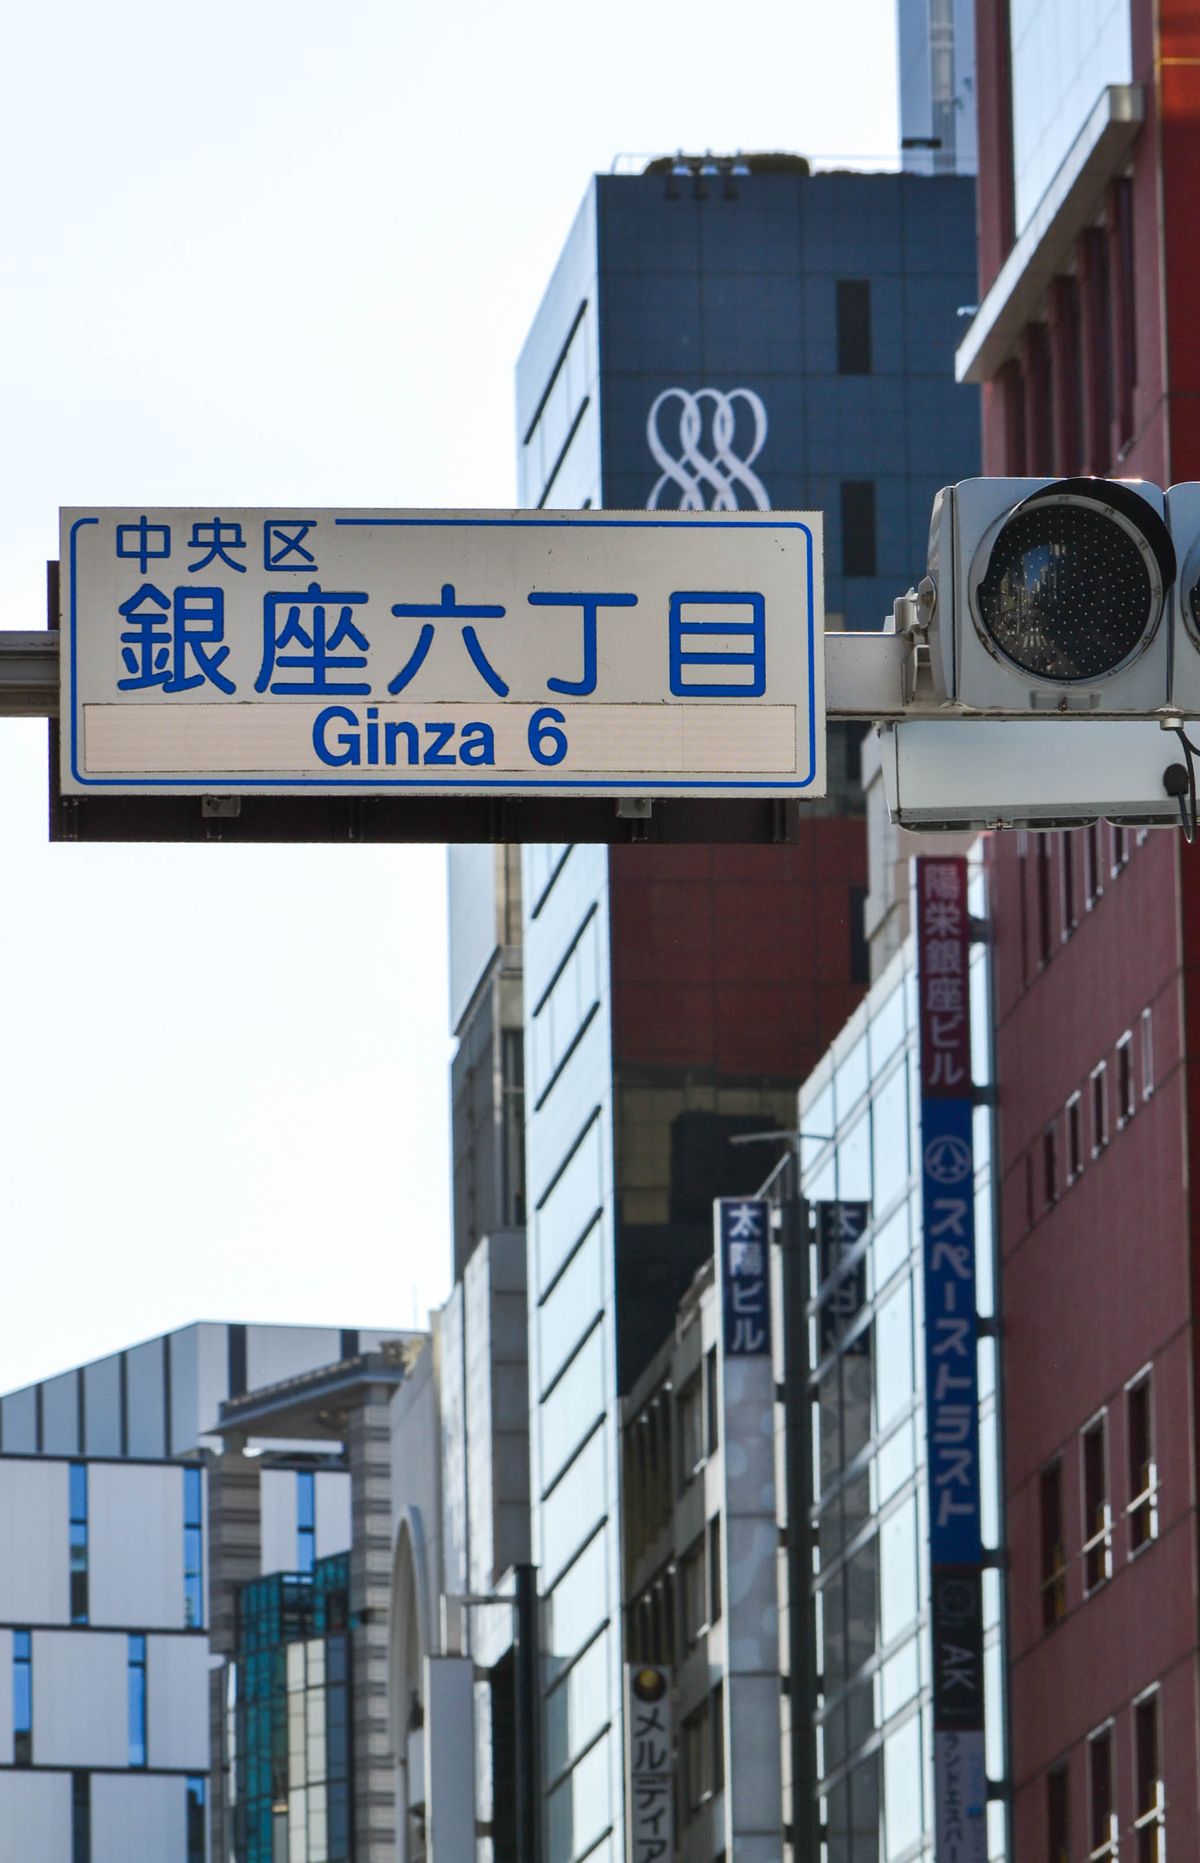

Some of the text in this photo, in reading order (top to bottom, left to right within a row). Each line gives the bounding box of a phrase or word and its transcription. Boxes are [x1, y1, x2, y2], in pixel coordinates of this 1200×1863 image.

[117, 515, 319, 574] 中央区
[117, 582, 767, 697] 銀座六丁目
[312, 705, 568, 767] Ginza 6
[930, 1199, 975, 1527] スペーストラスト
